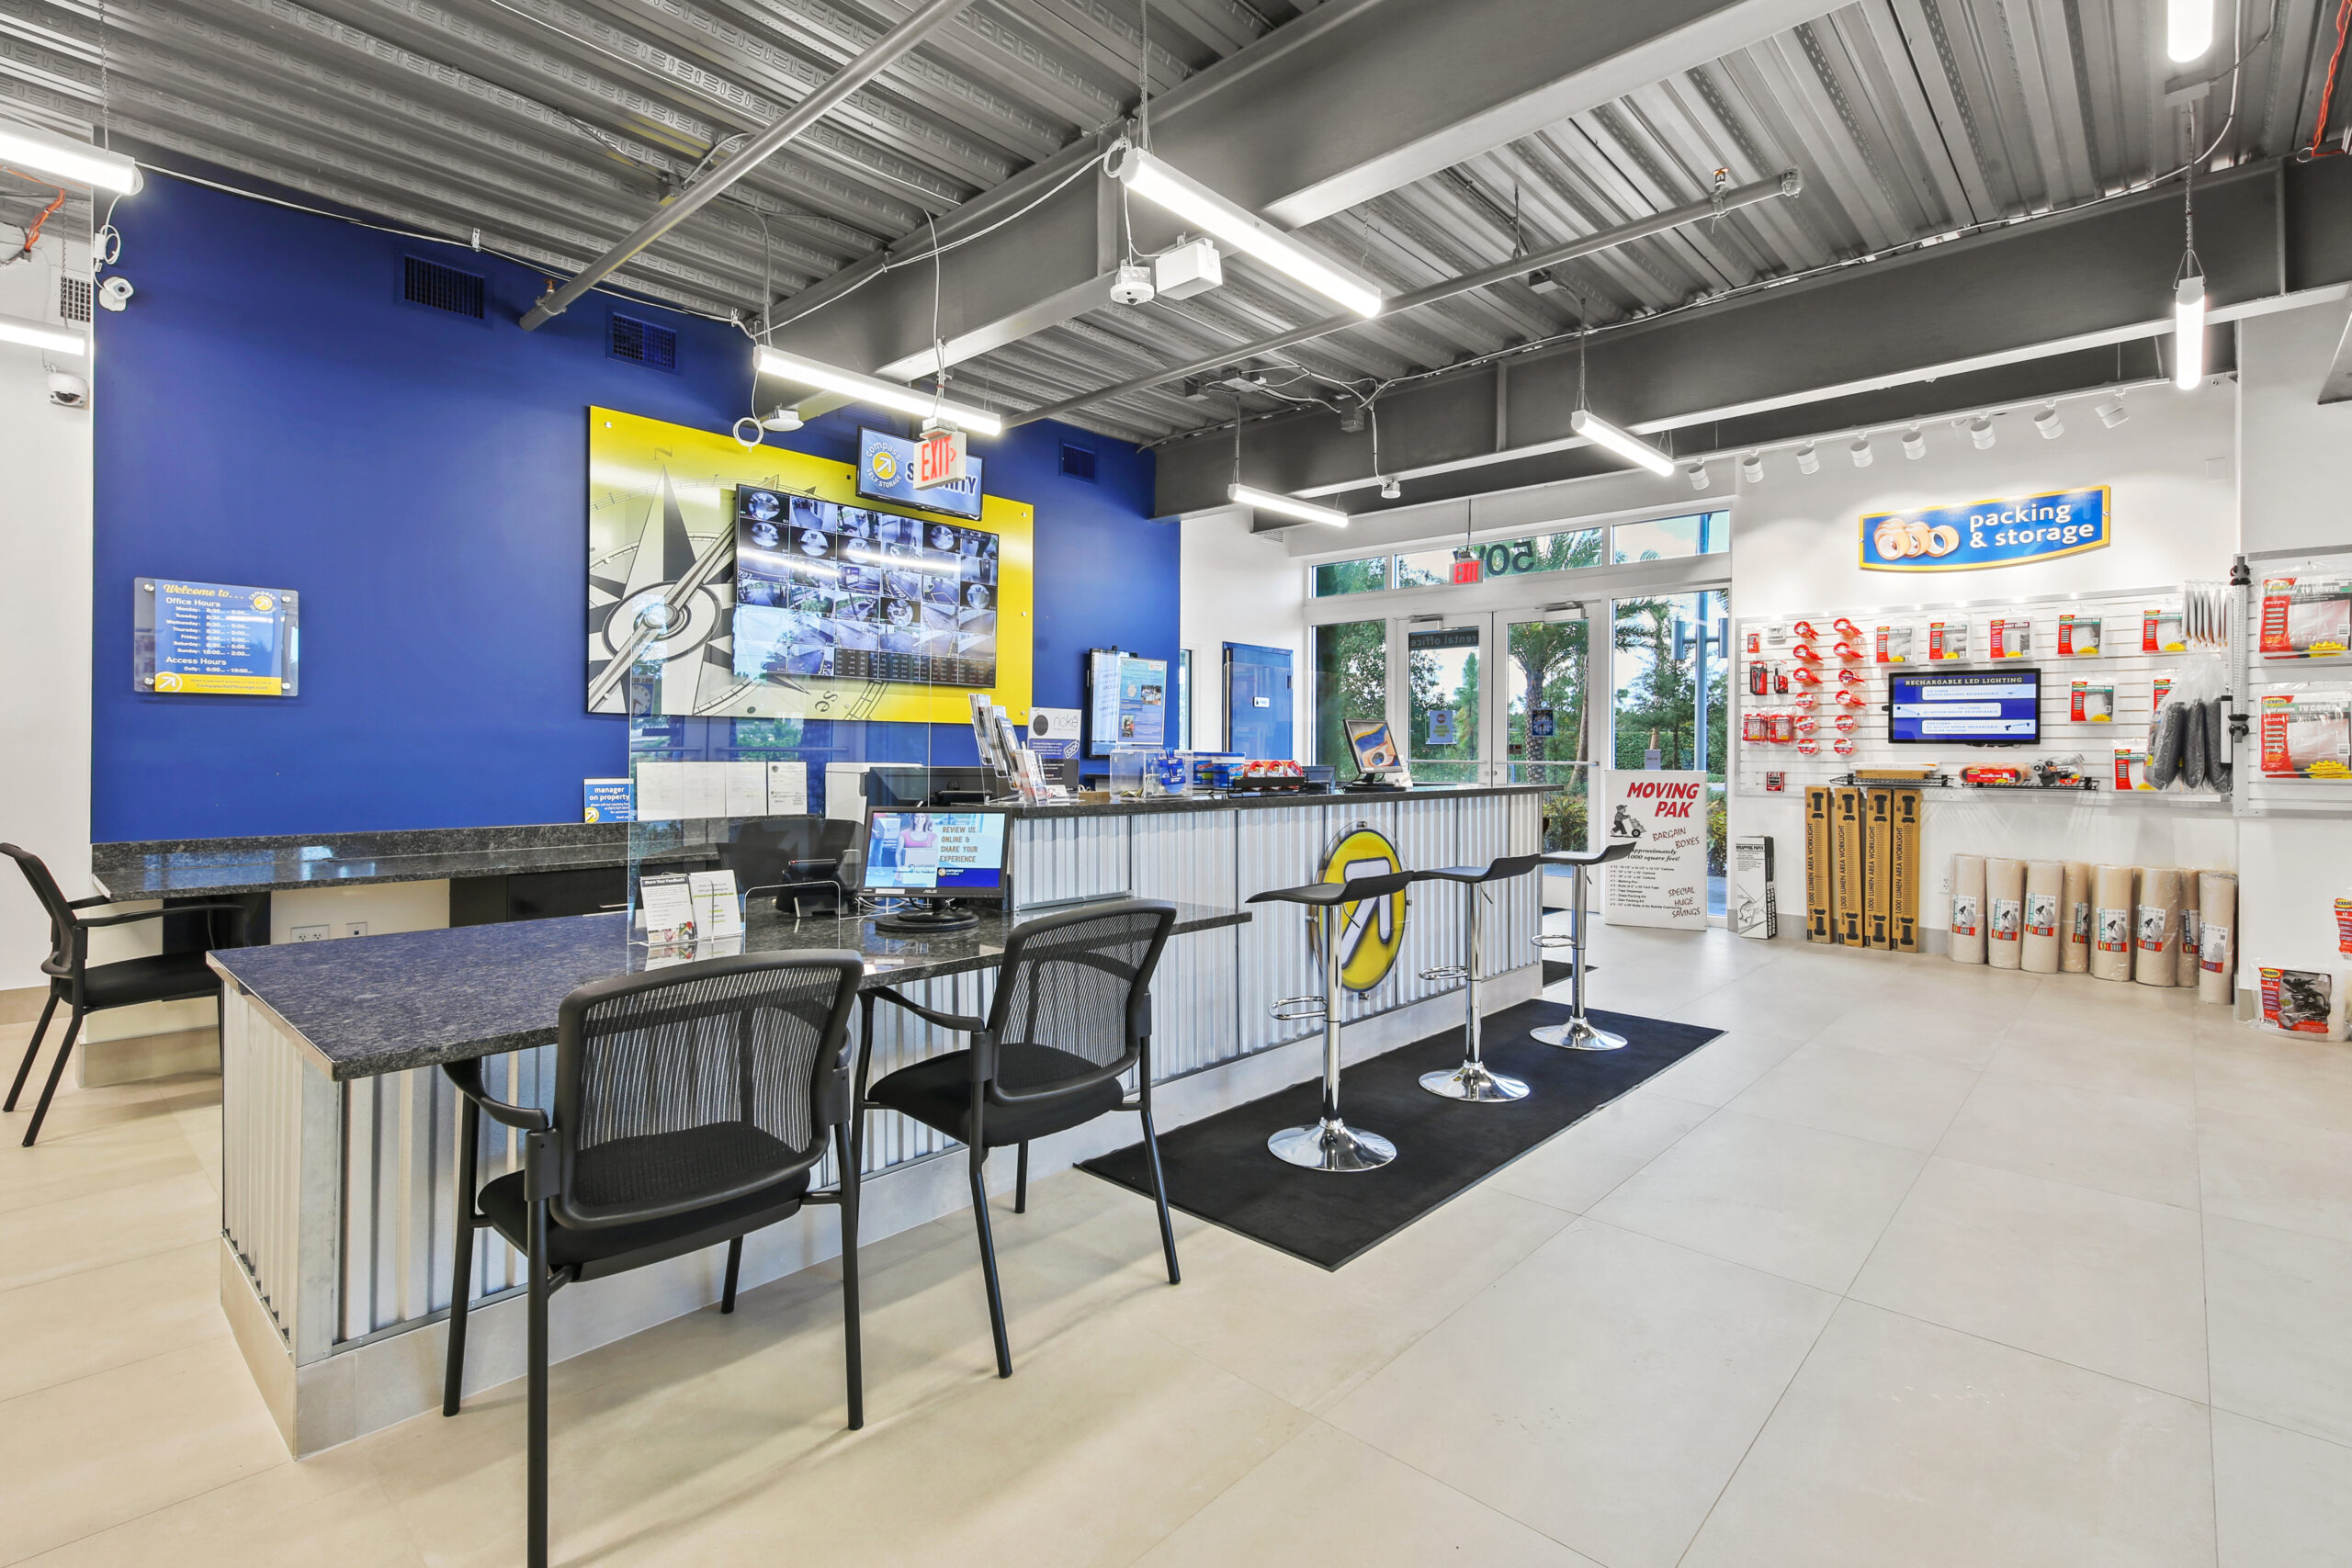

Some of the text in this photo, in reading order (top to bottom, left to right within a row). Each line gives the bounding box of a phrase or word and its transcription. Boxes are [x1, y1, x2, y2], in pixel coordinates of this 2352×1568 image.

[866, 442, 902, 462] compass
[922, 435, 953, 482] EXIT
[879, 474, 902, 488] STORAGE
[1969, 503, 2071, 533] packing
[1969, 523, 2095, 549] & storage
[1453, 560, 1481, 585] EXIT
[163, 584, 216, 597] Welcome
[165, 597, 221, 607] Office Hours
[1627, 782, 1700, 799] MOVING
[1655, 801, 1694, 818] PAK
[1653, 827, 1686, 842] BARGAIN
[1675, 836, 1700, 849] BOXES
[1668, 886, 1695, 897] SPECIAL
[1674, 897, 1694, 906] HUGE
[1672, 907, 1701, 918] SAVINGS
